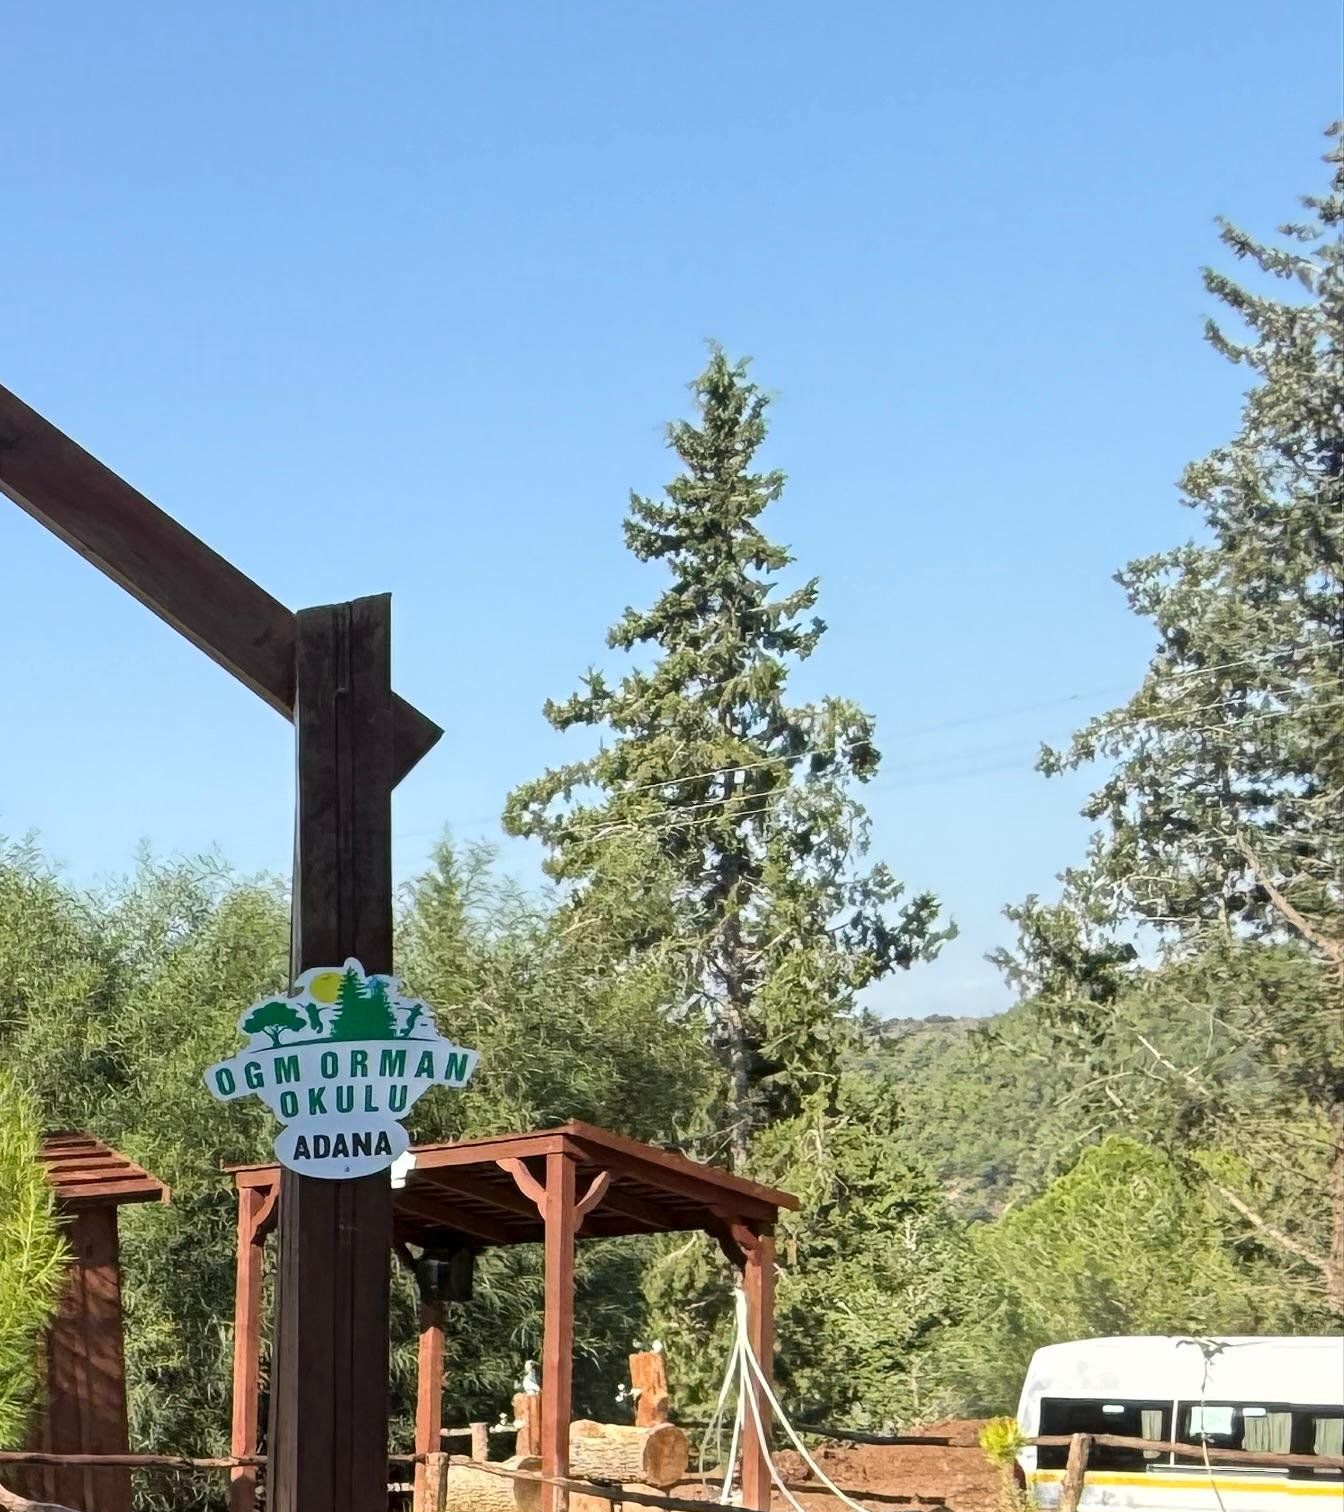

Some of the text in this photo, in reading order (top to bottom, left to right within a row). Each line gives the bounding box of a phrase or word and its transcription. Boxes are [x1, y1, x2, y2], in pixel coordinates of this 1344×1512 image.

[215, 1049, 469, 1096] OGM ORMAN
[280, 1084, 408, 1119] OKULU
[293, 1131, 392, 1161] ADANA
